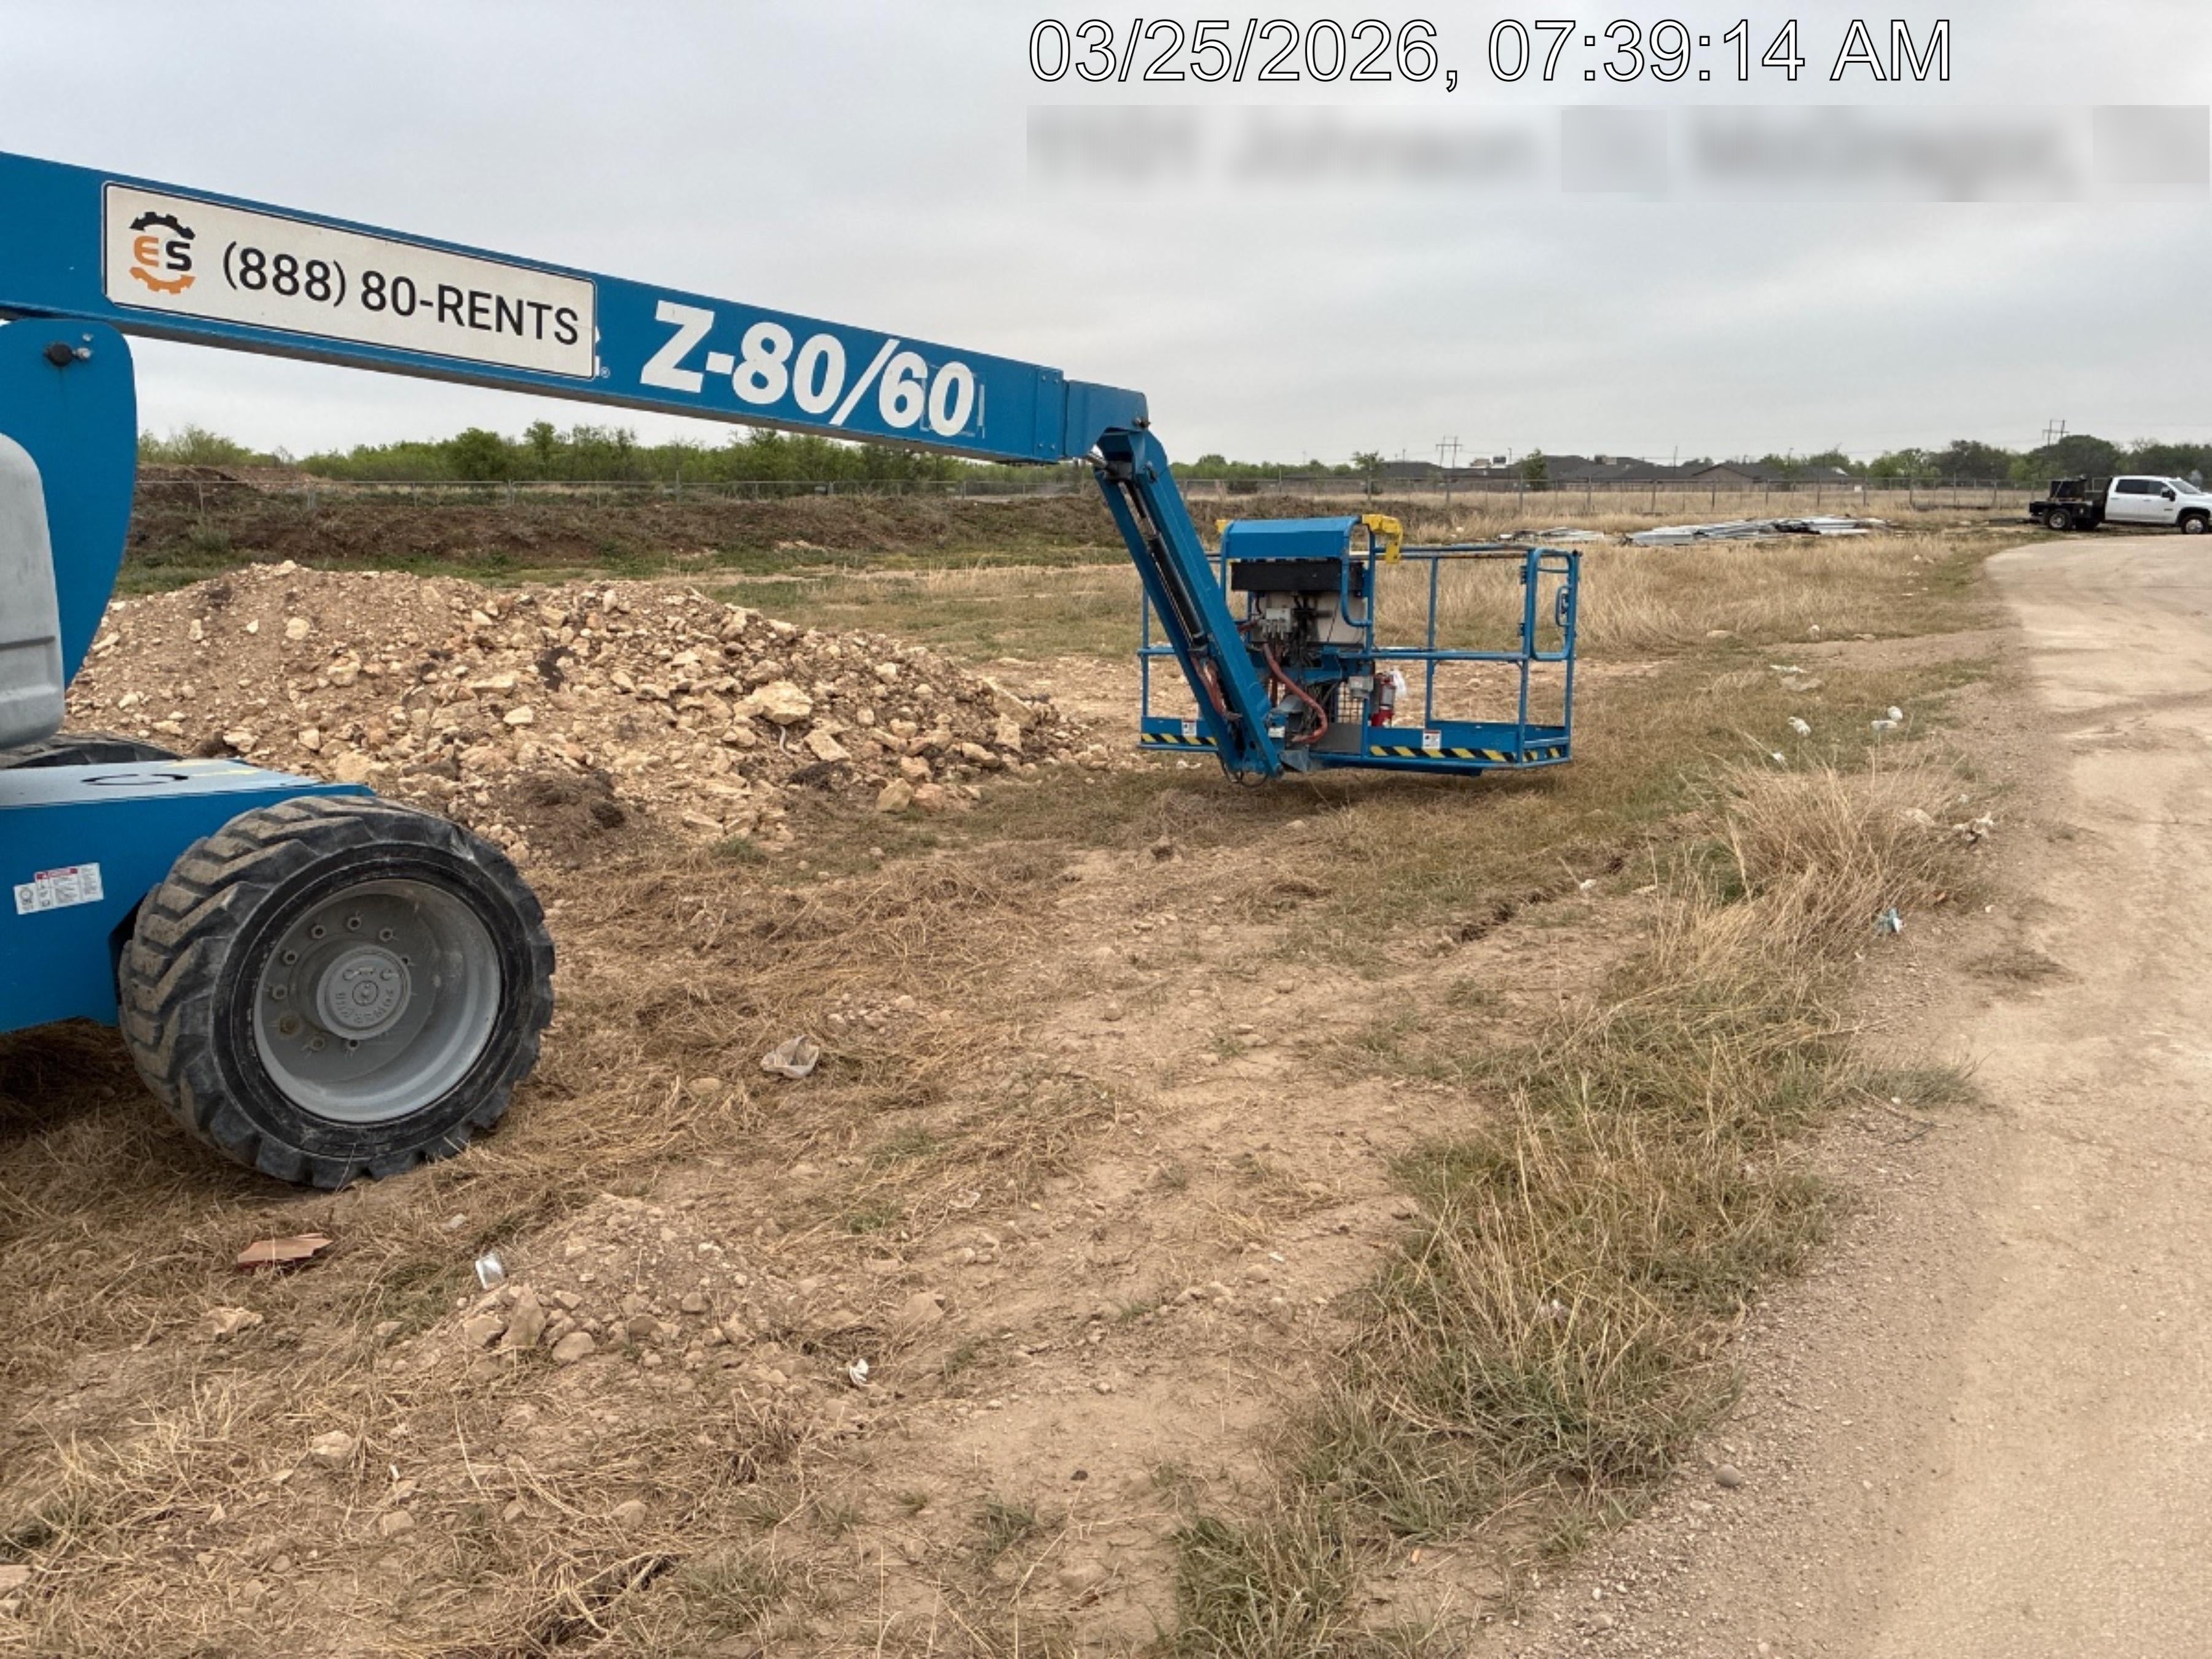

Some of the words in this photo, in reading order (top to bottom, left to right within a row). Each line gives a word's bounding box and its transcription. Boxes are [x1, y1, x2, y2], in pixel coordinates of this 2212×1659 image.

[133, 235, 192, 272] ES
[223, 240, 347, 308] (888)
[361, 270, 579, 345] 80-RENTS
[639, 299, 975, 437] Z-80/60
